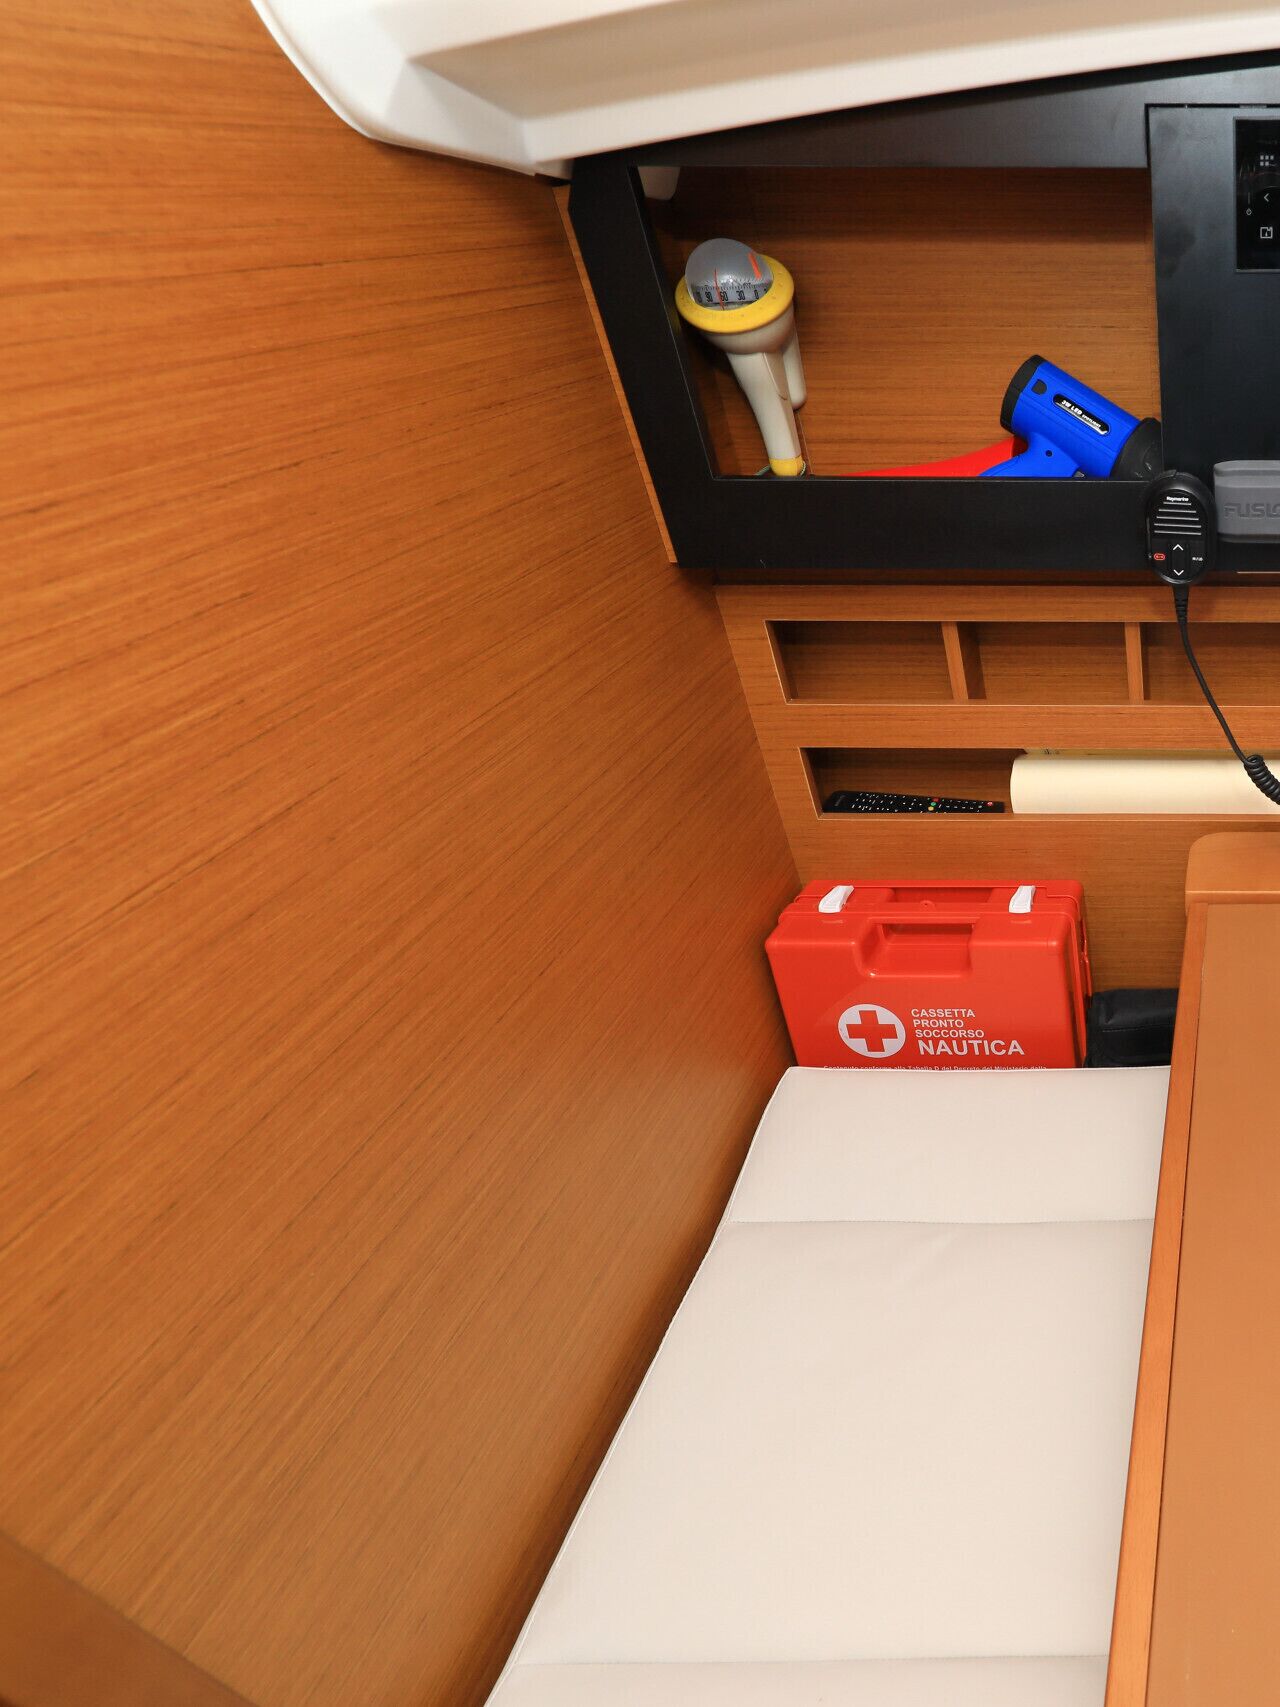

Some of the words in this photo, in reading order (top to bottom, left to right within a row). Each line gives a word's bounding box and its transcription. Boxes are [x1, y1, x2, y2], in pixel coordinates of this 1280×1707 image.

[1071, 405, 1083, 415] LED
[910, 1008, 976, 1018] CASSETTA
[912, 1019, 964, 1028] PRONTO
[914, 1029, 985, 1039] SOCCORSO
[917, 1039, 1025, 1057] NAUTICA
